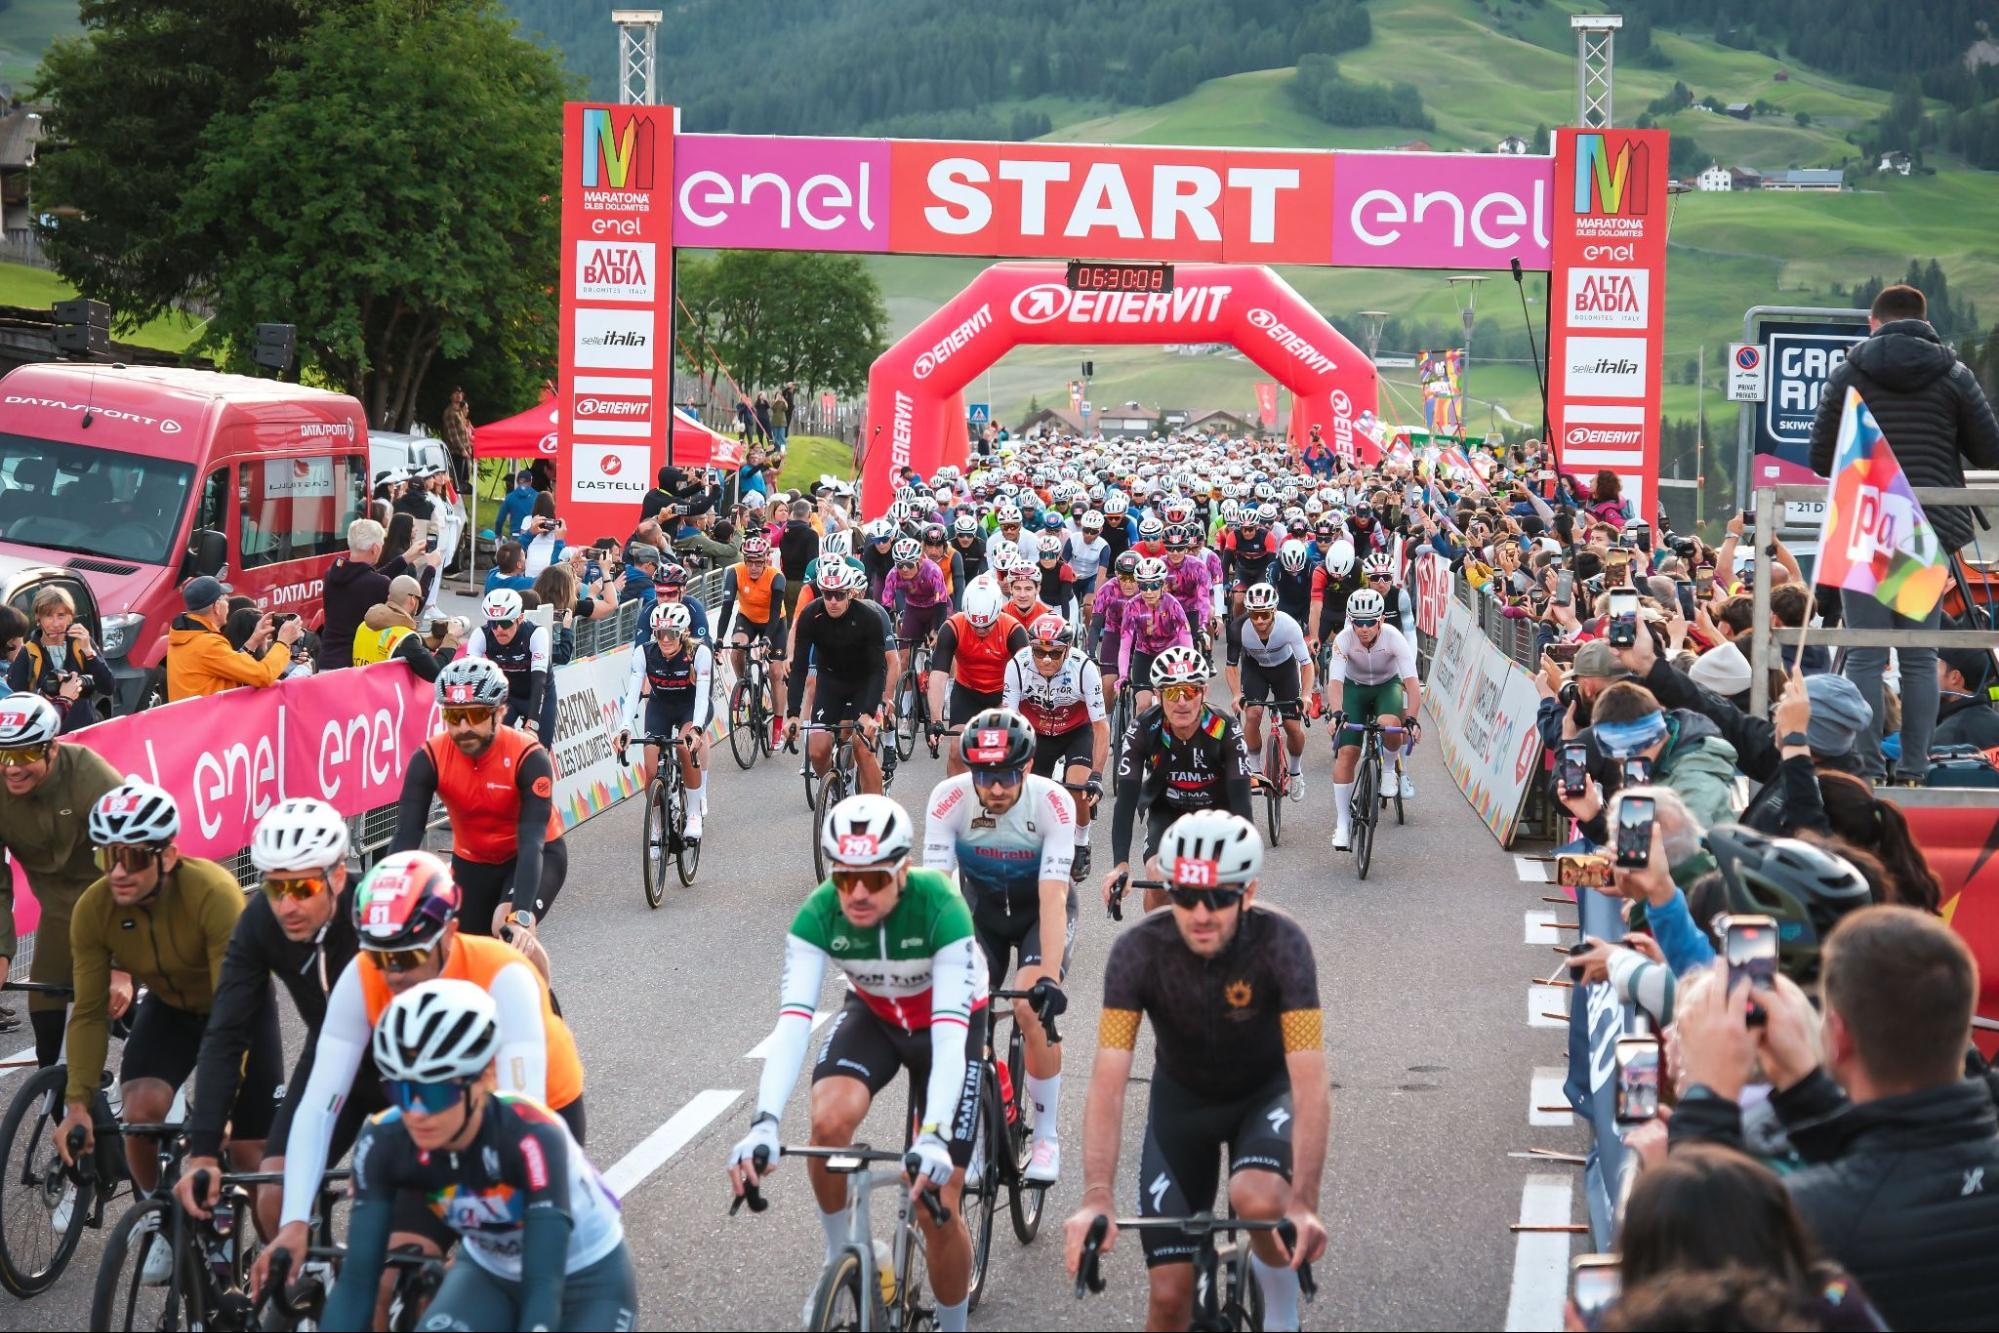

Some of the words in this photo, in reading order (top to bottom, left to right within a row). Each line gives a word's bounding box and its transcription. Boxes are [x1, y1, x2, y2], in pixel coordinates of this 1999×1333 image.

[584, 191, 649, 204] MARATONA
[679, 162, 875, 231] enel
[924, 157, 1300, 244] START
[584, 203, 604, 211] DLES
[605, 203, 649, 212] DOLOMITES
[1351, 179, 1550, 249] enel
[591, 218, 641, 235] enel
[1576, 218, 1643, 230] MARATONA
[1576, 229, 1596, 237] DLES
[1597, 229, 1643, 238] DOLOMITES
[591, 249, 641, 266] ALTA
[1583, 243, 1634, 261] enel
[583, 265, 647, 286] BADIA
[1078, 267, 1163, 289] 06:30:08
[1583, 275, 1634, 293] ALTA
[1068, 286, 1233, 323] ENERVIT
[1575, 293, 1639, 312] BADIA
[932, 303, 993, 364] ENERVIT
[1266, 320, 1338, 376] ENERVIT
[1780, 380, 1832, 410] RI
[6, 395, 157, 426] DATASPORT
[598, 401, 650, 415] ENERVIT
[301, 423, 347, 437] DATASPORT
[893, 391, 914, 479] ENERVIT
[1588, 429, 1641, 444] ENERVIT
[577, 480, 645, 491] CASTELLI
[1797, 503, 1810, 512] 21
[976, 615, 986, 624] 55
[319, 682, 403, 799] enel
[983, 733, 1000, 747] 25
[193, 705, 288, 839] enel
[931, 787, 965, 822] felicetti
[1046, 790, 1071, 825] felicetti
[1178, 864, 1210, 884] 321
[954, 1060, 980, 1140] SANTINI
